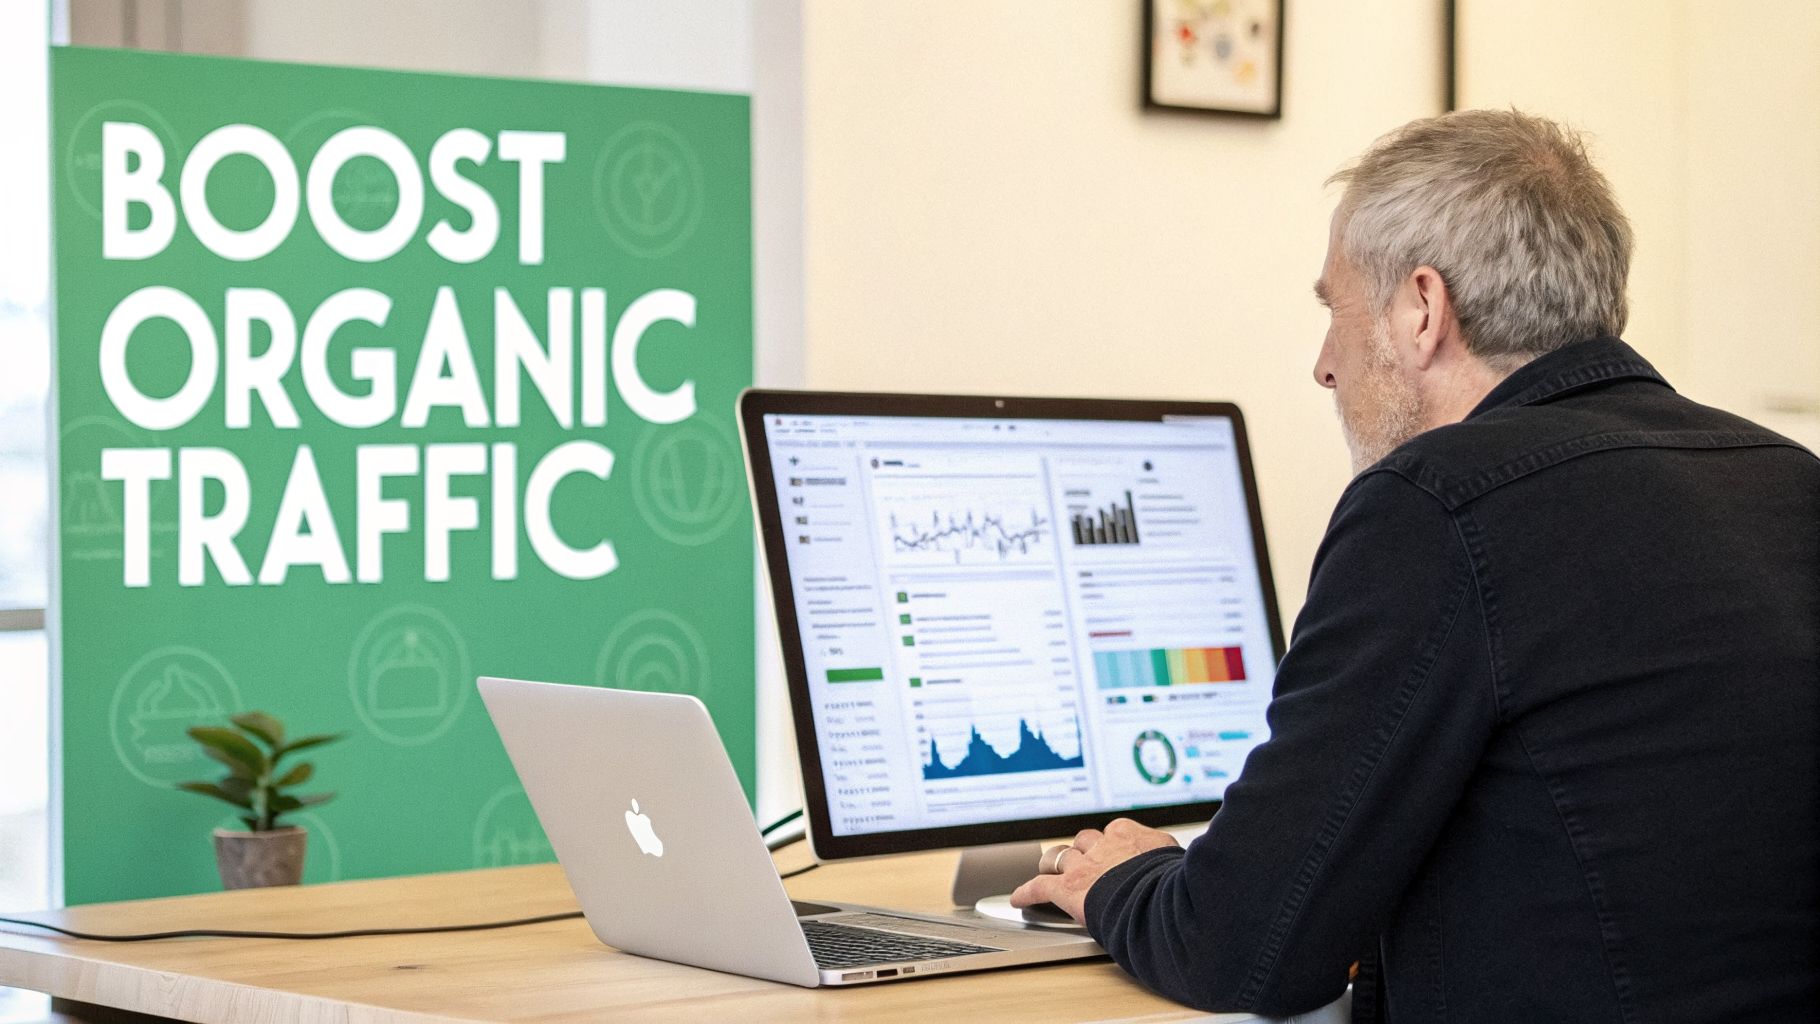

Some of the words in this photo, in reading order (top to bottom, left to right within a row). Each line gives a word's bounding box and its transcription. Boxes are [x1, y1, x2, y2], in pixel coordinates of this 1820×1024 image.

[102, 122, 567, 265] BOOST
[99, 286, 697, 430] ORGANIC
[101, 440, 618, 587] TRAFFIC
